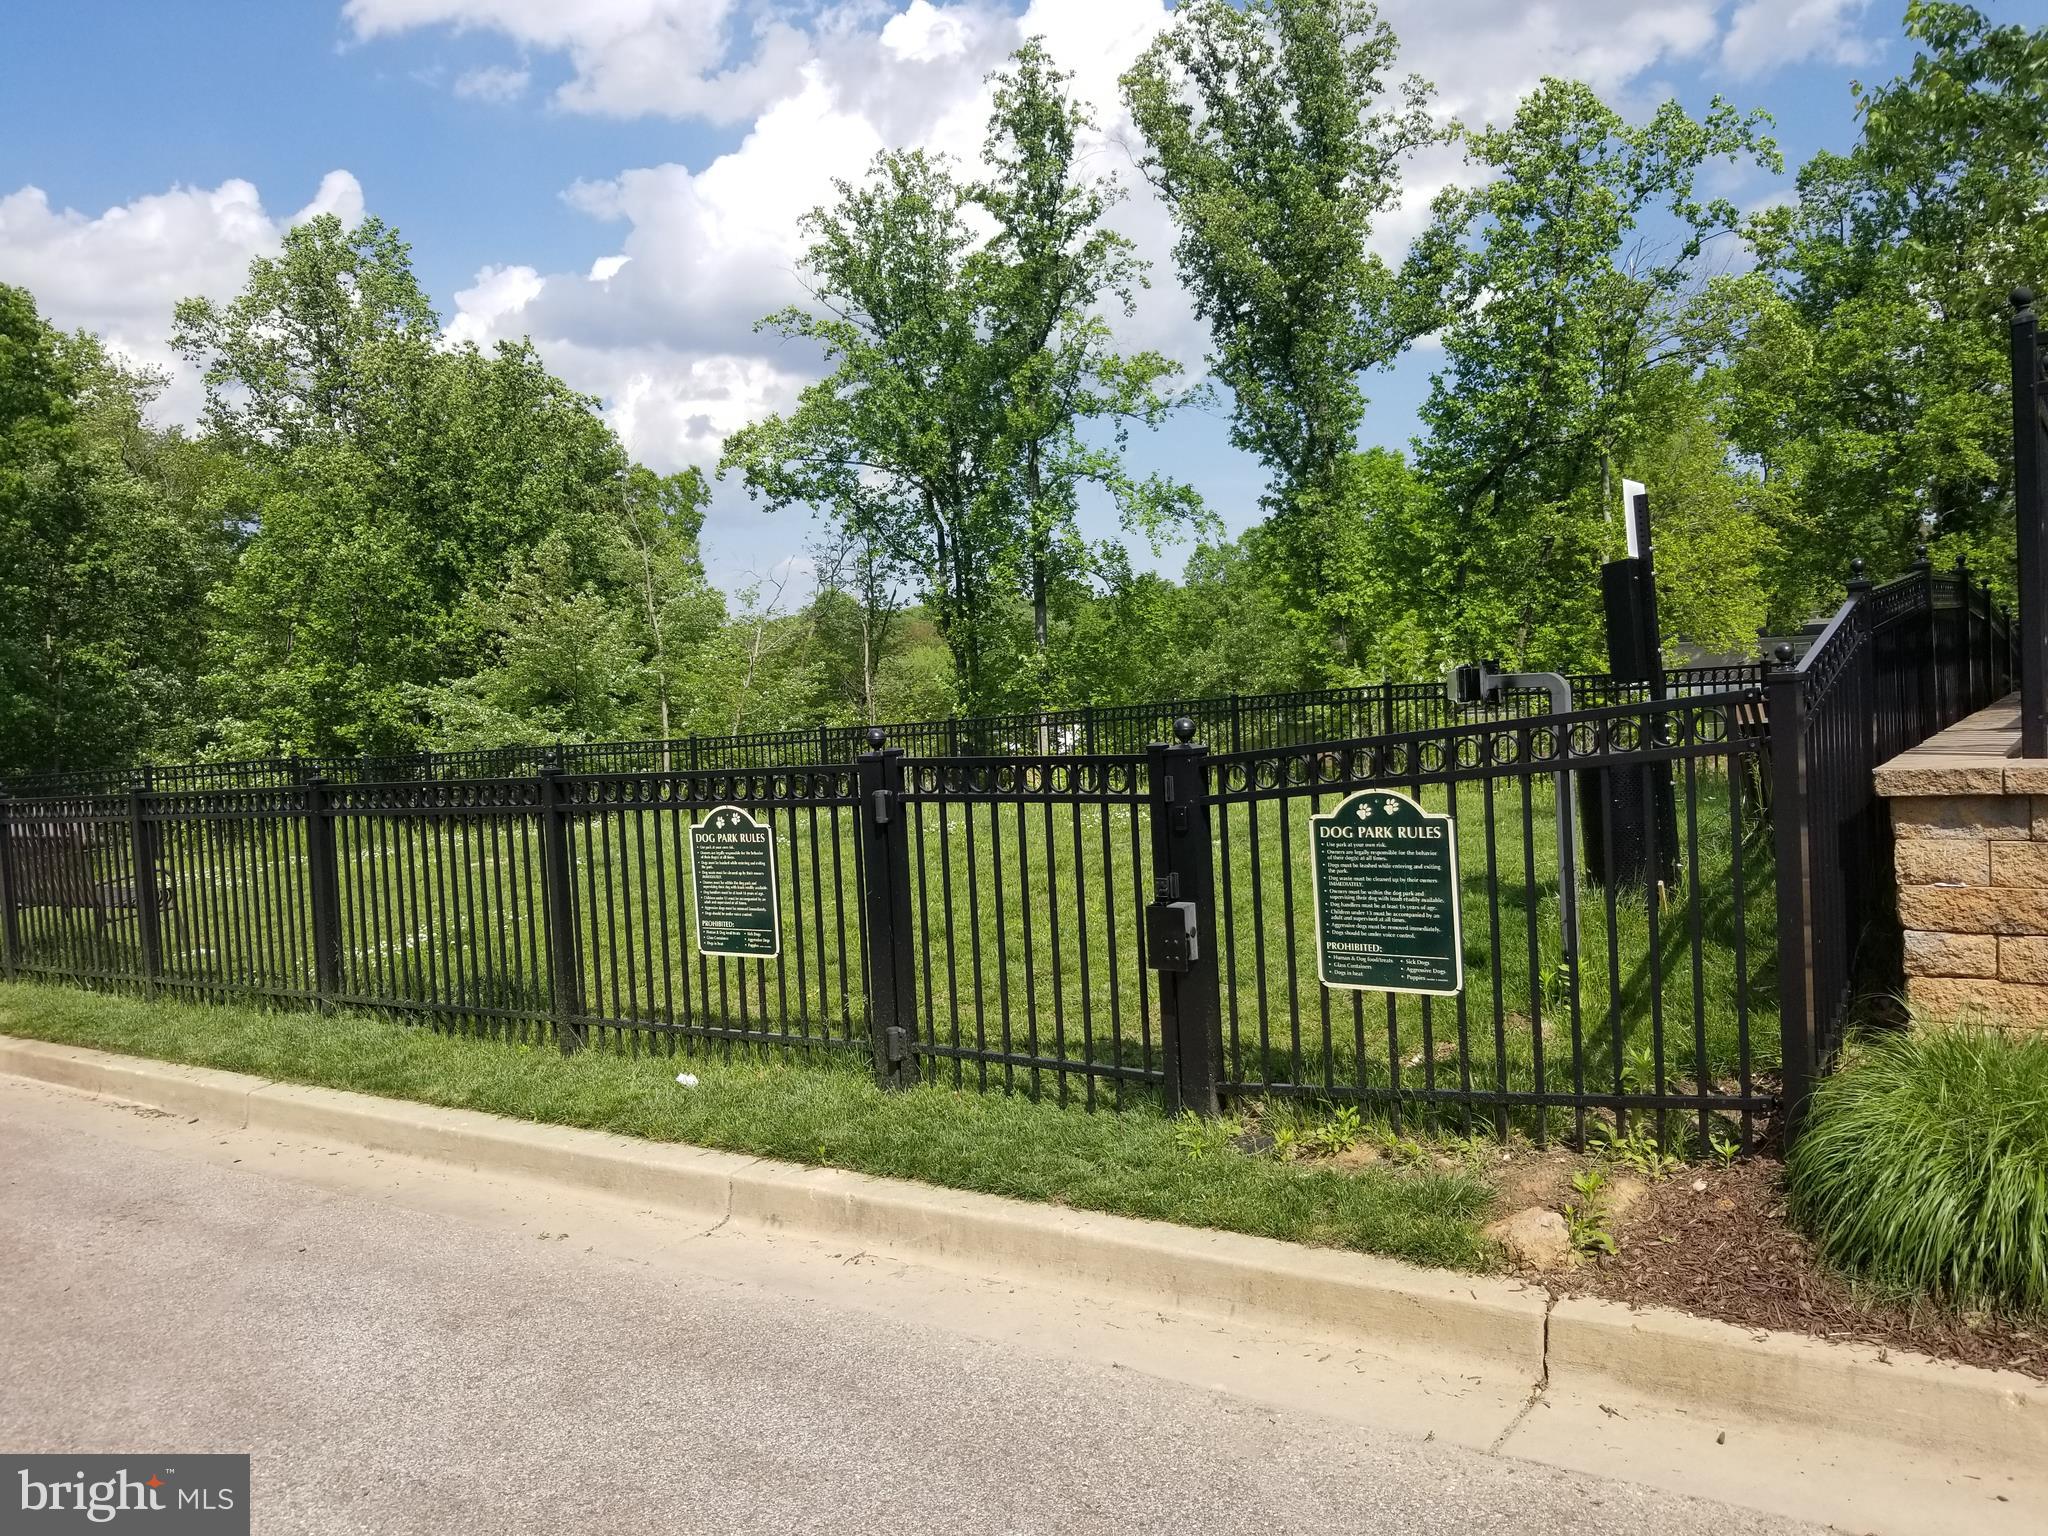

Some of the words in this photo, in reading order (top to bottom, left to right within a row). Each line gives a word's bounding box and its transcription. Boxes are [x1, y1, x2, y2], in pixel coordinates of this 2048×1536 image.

[1320, 827, 1353, 838] DOG
[1358, 827, 1393, 838] PARK
[1398, 827, 1441, 838] RULES
[696, 834, 715, 842] DOG
[718, 834, 738, 842] PARK
[740, 834, 765, 842] RULES
[1326, 942, 1382, 952] PROHIBITED:
